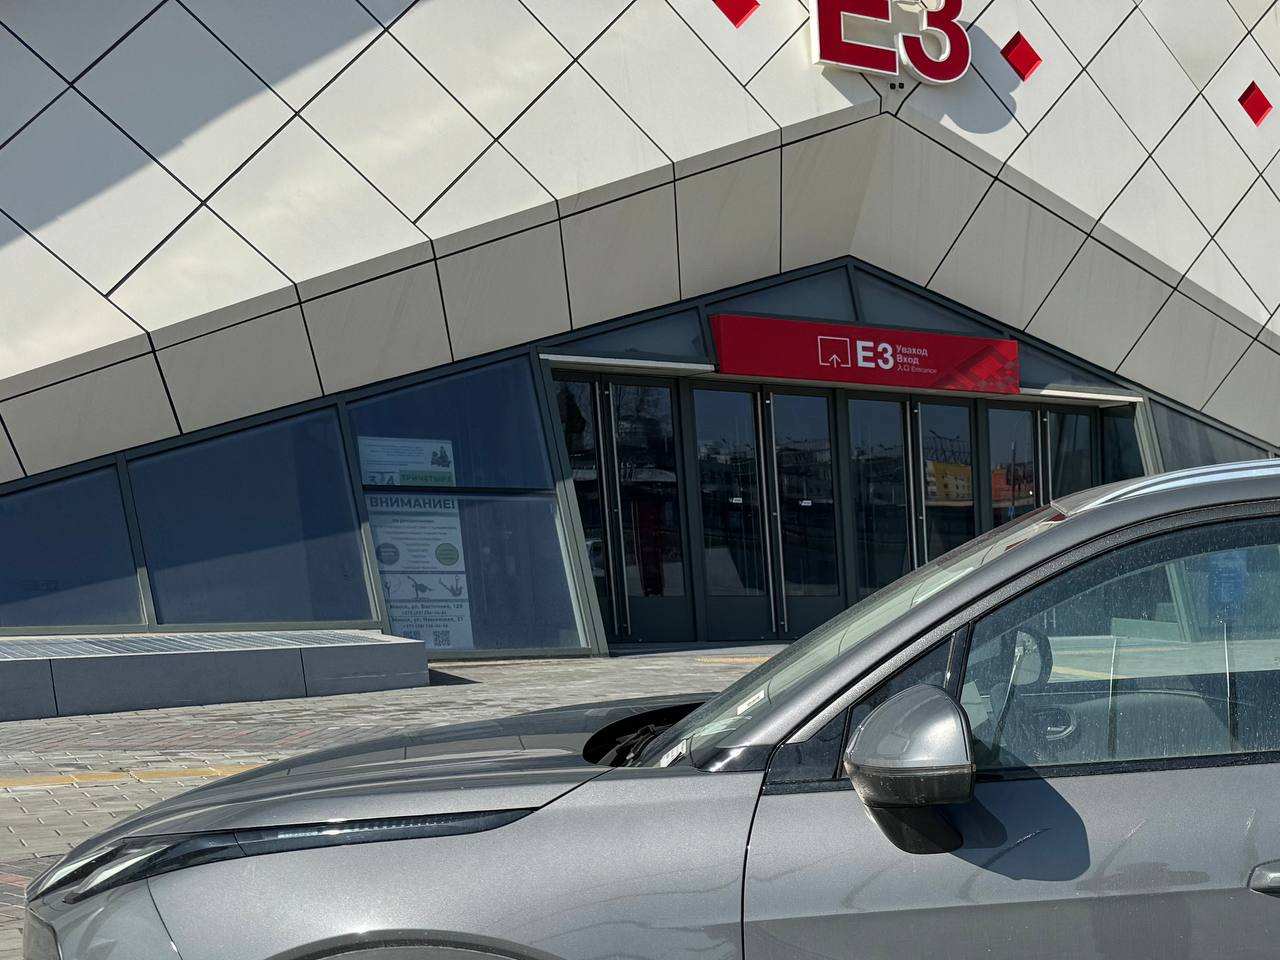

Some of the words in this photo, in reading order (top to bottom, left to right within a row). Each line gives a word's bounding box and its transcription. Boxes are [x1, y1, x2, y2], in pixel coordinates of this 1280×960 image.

[814, 0, 972, 83] E3
[856, 340, 894, 370] E3
[896, 344, 928, 357] Уваход
[896, 354, 920, 365] Вход
[369, 496, 456, 510] ВНИМАНИЕ!
